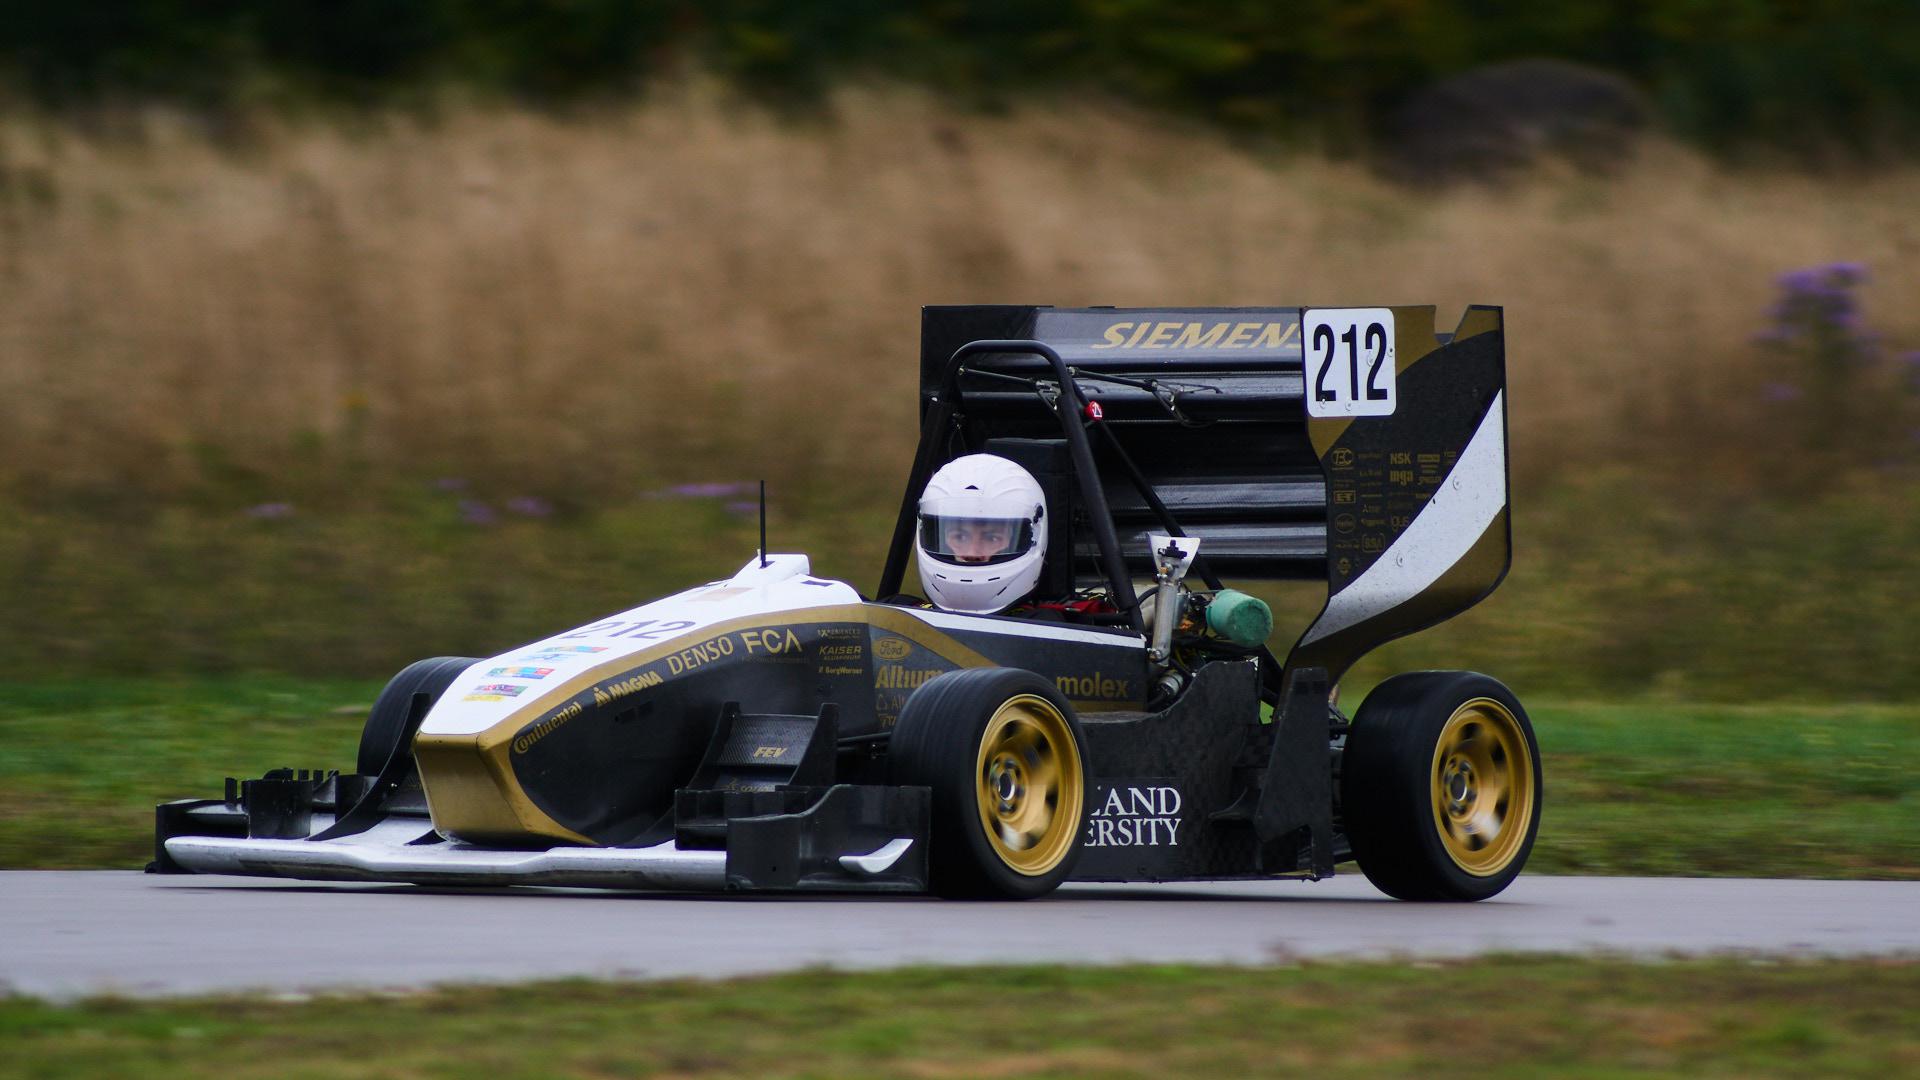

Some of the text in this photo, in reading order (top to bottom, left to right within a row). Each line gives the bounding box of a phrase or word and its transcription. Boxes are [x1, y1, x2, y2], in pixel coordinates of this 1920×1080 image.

[1091, 322, 1303, 349] SIEMEN
[1313, 322, 1388, 402] 212
[1389, 452, 1412, 465] NSK
[560, 619, 696, 639] 212
[740, 629, 803, 655] FCA
[666, 636, 734, 675] DENSO
[819, 645, 863, 655] KAISER
[825, 665, 863, 676] BorgWarner
[608, 671, 664, 700] MAGNA
[1056, 671, 1129, 698] molex
[513, 701, 583, 754] Continental
[753, 746, 788, 758] FEV
